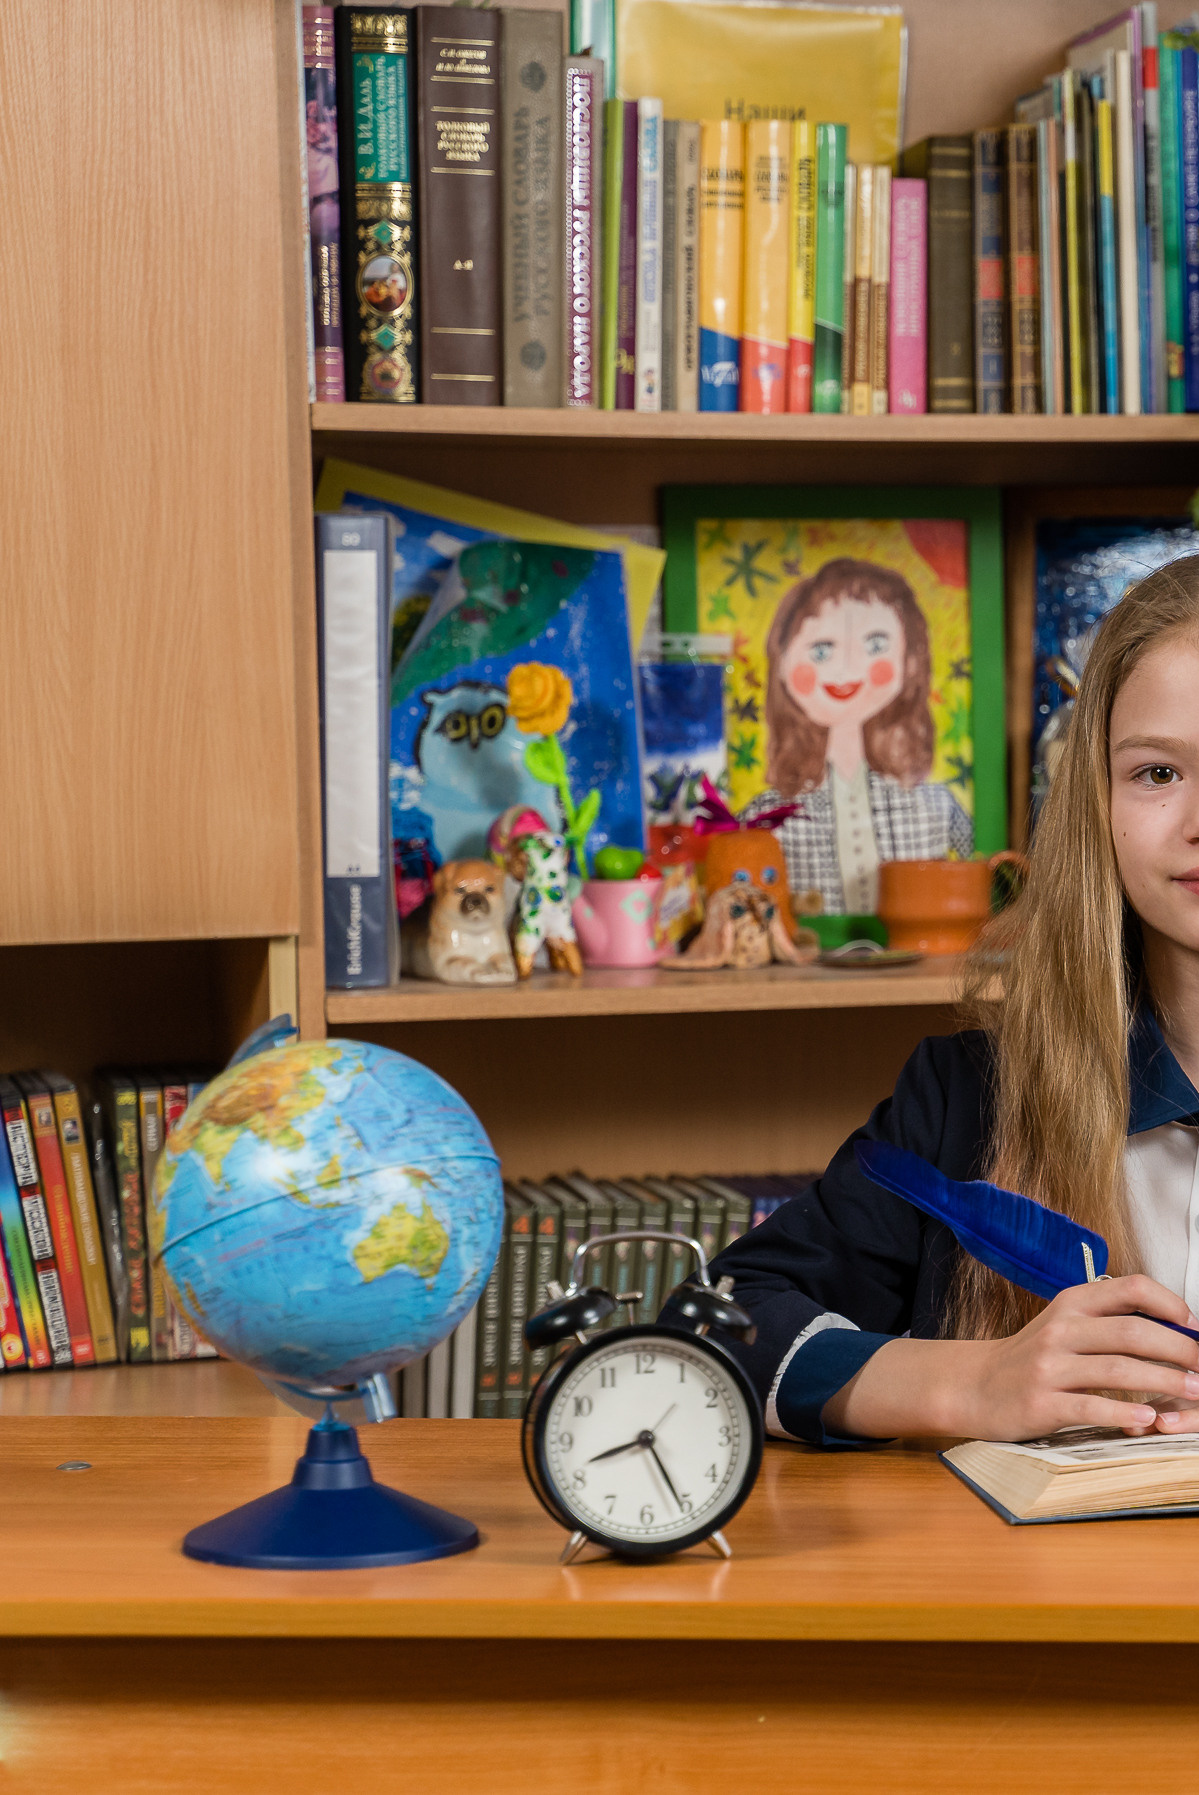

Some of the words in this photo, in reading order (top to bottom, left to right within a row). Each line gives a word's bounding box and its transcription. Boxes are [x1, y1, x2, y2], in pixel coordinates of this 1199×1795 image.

[375, 56, 387, 111] СЛОВАРЬ
[387, 108, 398, 171] РУССКОГО
[571, 76, 591, 206] ПОСЛОВИЦЫ
[1185, 90, 1198, 205] САНКТ-ПЕТЕРБУРГЕ
[511, 106, 530, 207] СЛОВАРЬ
[571, 208, 591, 314] РУССКОГО
[571, 315, 591, 398] НАРОДА
[347, 884, 362, 975] ErichKrause
[513, 1216, 531, 1234] 4
[538, 1216, 556, 1234] 4
[634, 1353, 656, 1374] 12
[677, 1363, 686, 1383] 1
[600, 1367, 617, 1388] 11
[572, 1396, 593, 1417] 10
[705, 1388, 718, 1408] 2
[559, 1432, 573, 1453] 9
[718, 1425, 732, 1447] 3
[572, 1469, 586, 1491] 8
[704, 1463, 718, 1484] 4
[603, 1495, 617, 1515] 7
[679, 1492, 693, 1513] 5
[639, 1504, 655, 1526] 6
